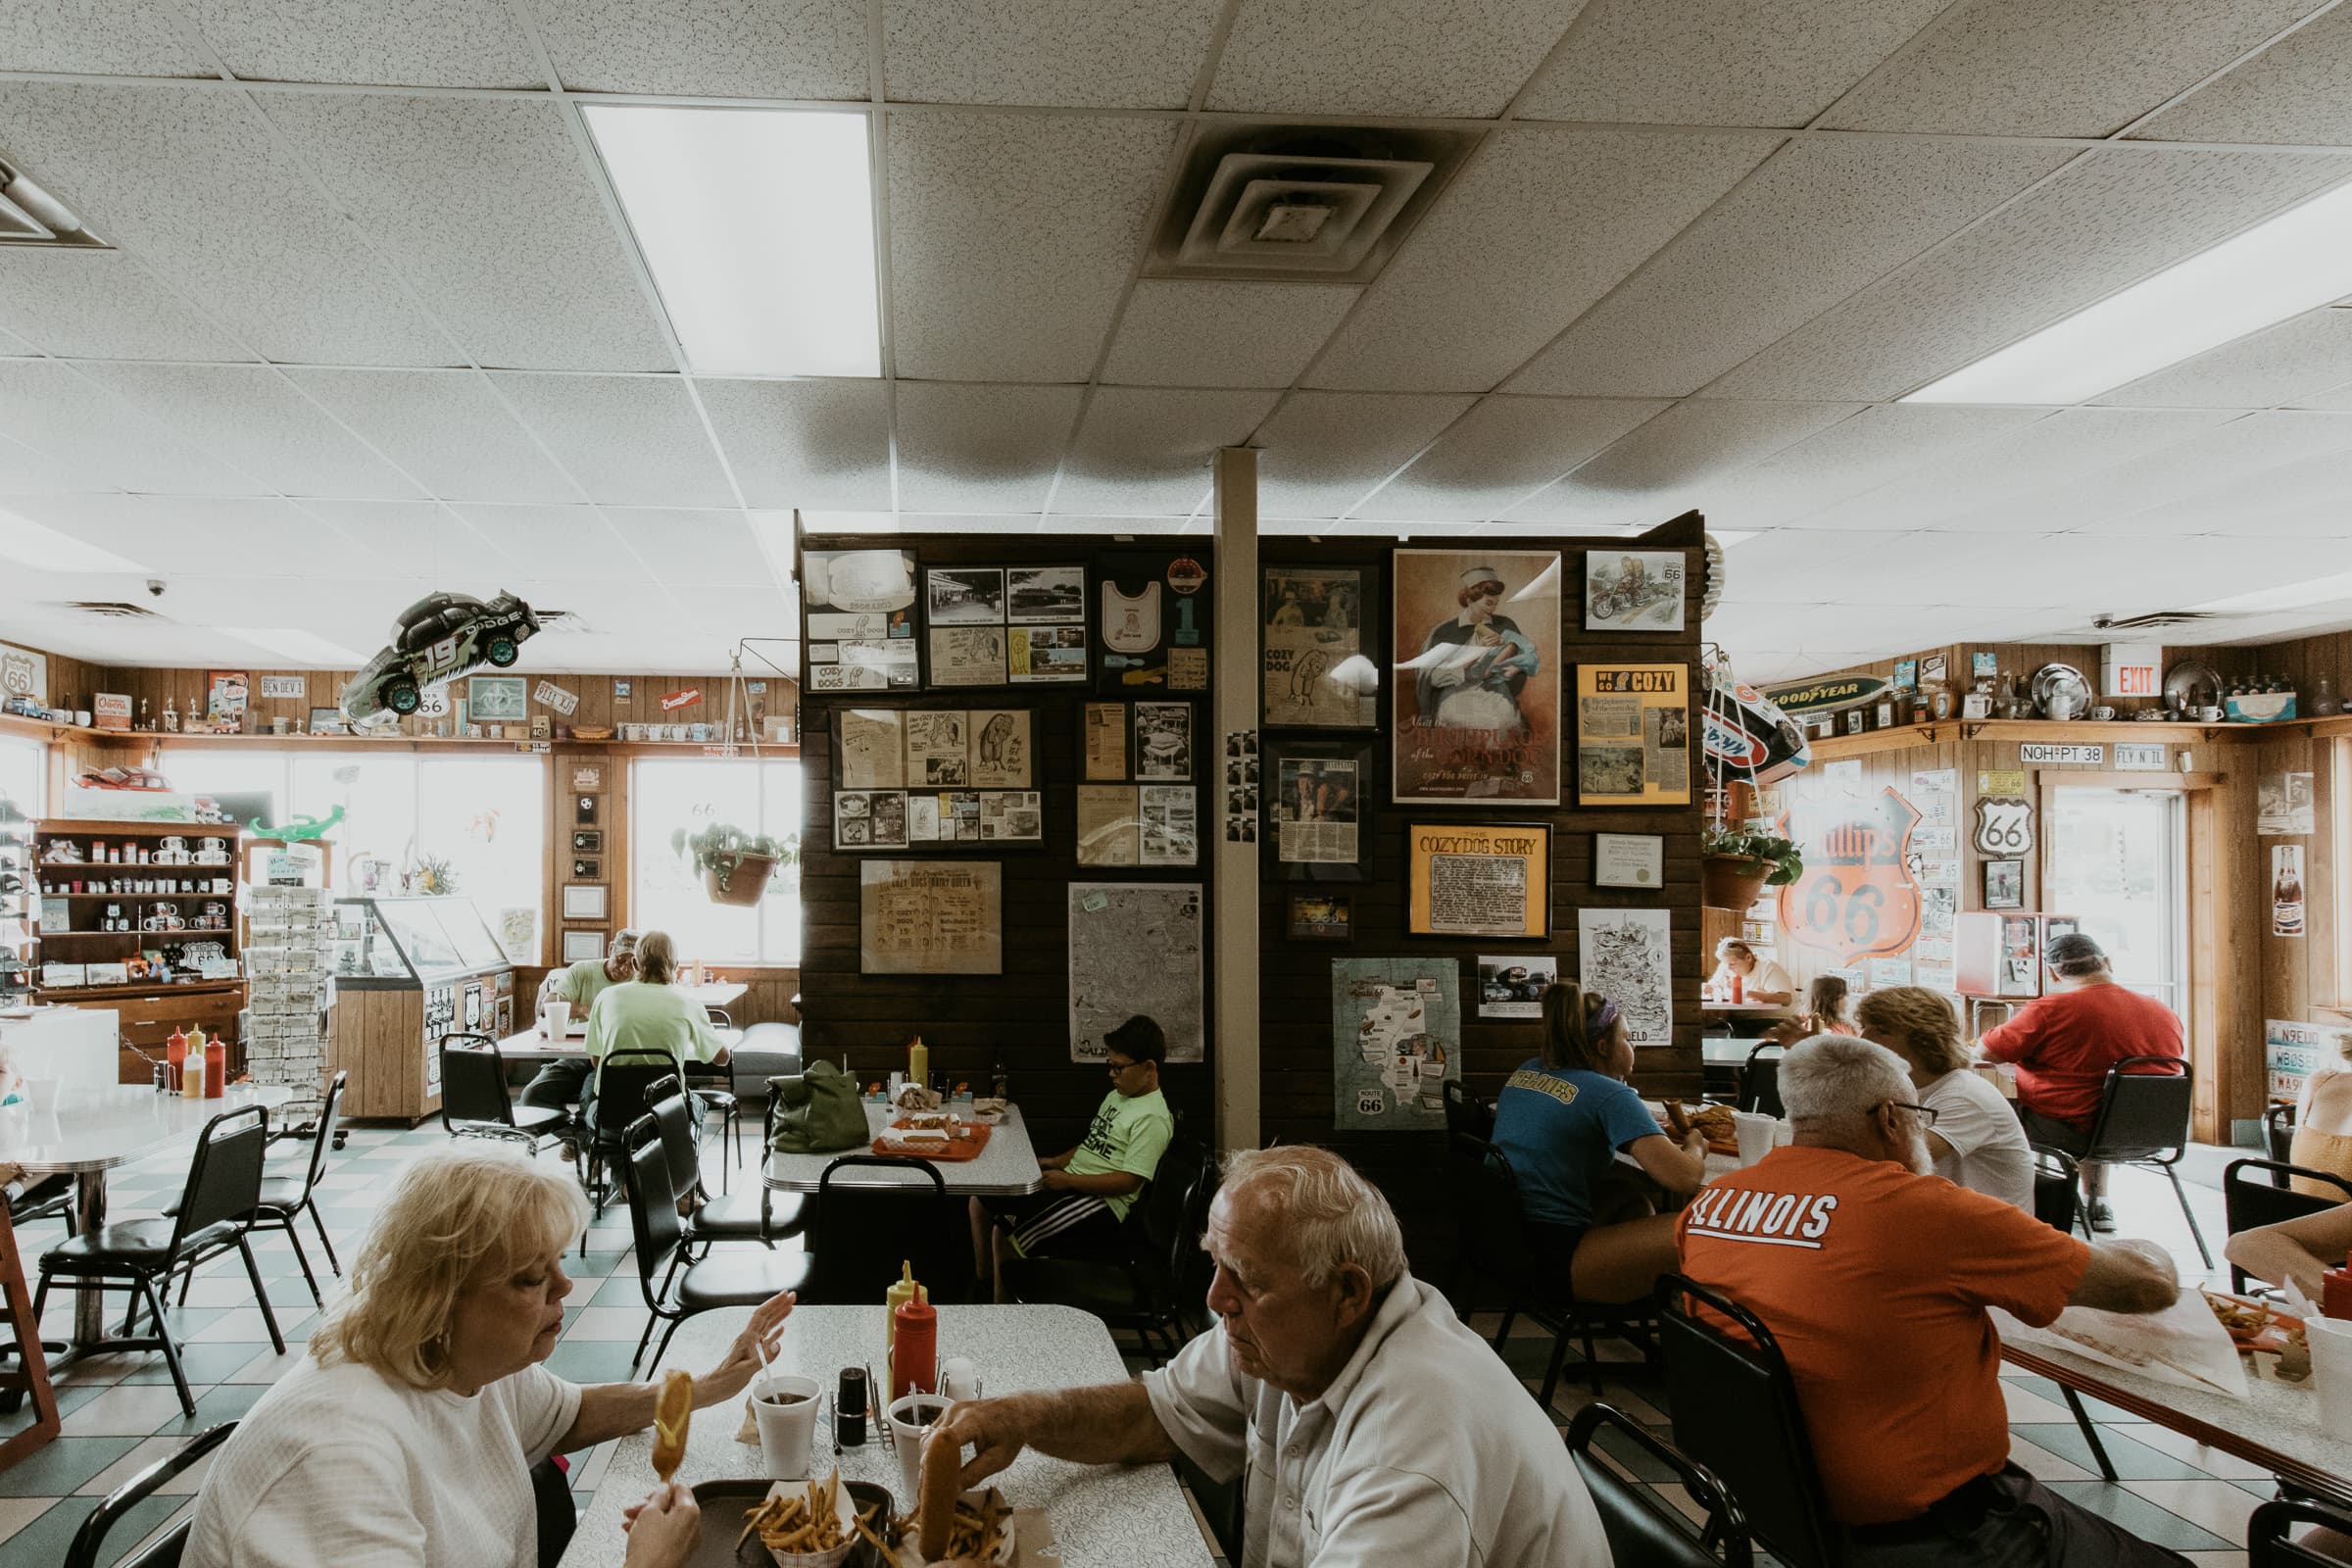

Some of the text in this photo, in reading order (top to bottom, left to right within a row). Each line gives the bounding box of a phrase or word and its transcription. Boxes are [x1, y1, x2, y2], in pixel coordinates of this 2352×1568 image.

[1665, 569, 1681, 579] 66
[466, 612, 521, 635] DODGE
[424, 636, 458, 673] 19
[1266, 649, 1295, 660] COZY
[8, 662, 30, 672] ROUTE
[818, 667, 843, 676] COZY
[1266, 662, 1291, 671] DOG
[8, 671, 27, 690] 66
[817, 678, 843, 688] DOGS
[1632, 672, 1674, 691] COZY
[2120, 666, 2153, 693] EXIT
[263, 681, 278, 693] BEN
[419, 700, 443, 713] 66
[1435, 716, 1446, 727] the
[1422, 748, 1434, 759] the
[2023, 746, 2101, 761] NOH PT 38
[2116, 751, 2164, 764] FLY N IL
[1985, 814, 2022, 847] 66
[1940, 833, 1951, 842] 66
[1419, 836, 1537, 856] COZY DOG STORY
[1946, 863, 1957, 878] 65
[1806, 875, 1886, 946] 66
[1374, 988, 1385, 997] 66
[1626, 1031, 1648, 1043] ELD
[1359, 1099, 1382, 1112] 66
[1688, 1188, 1838, 1239] ILLINOIS
